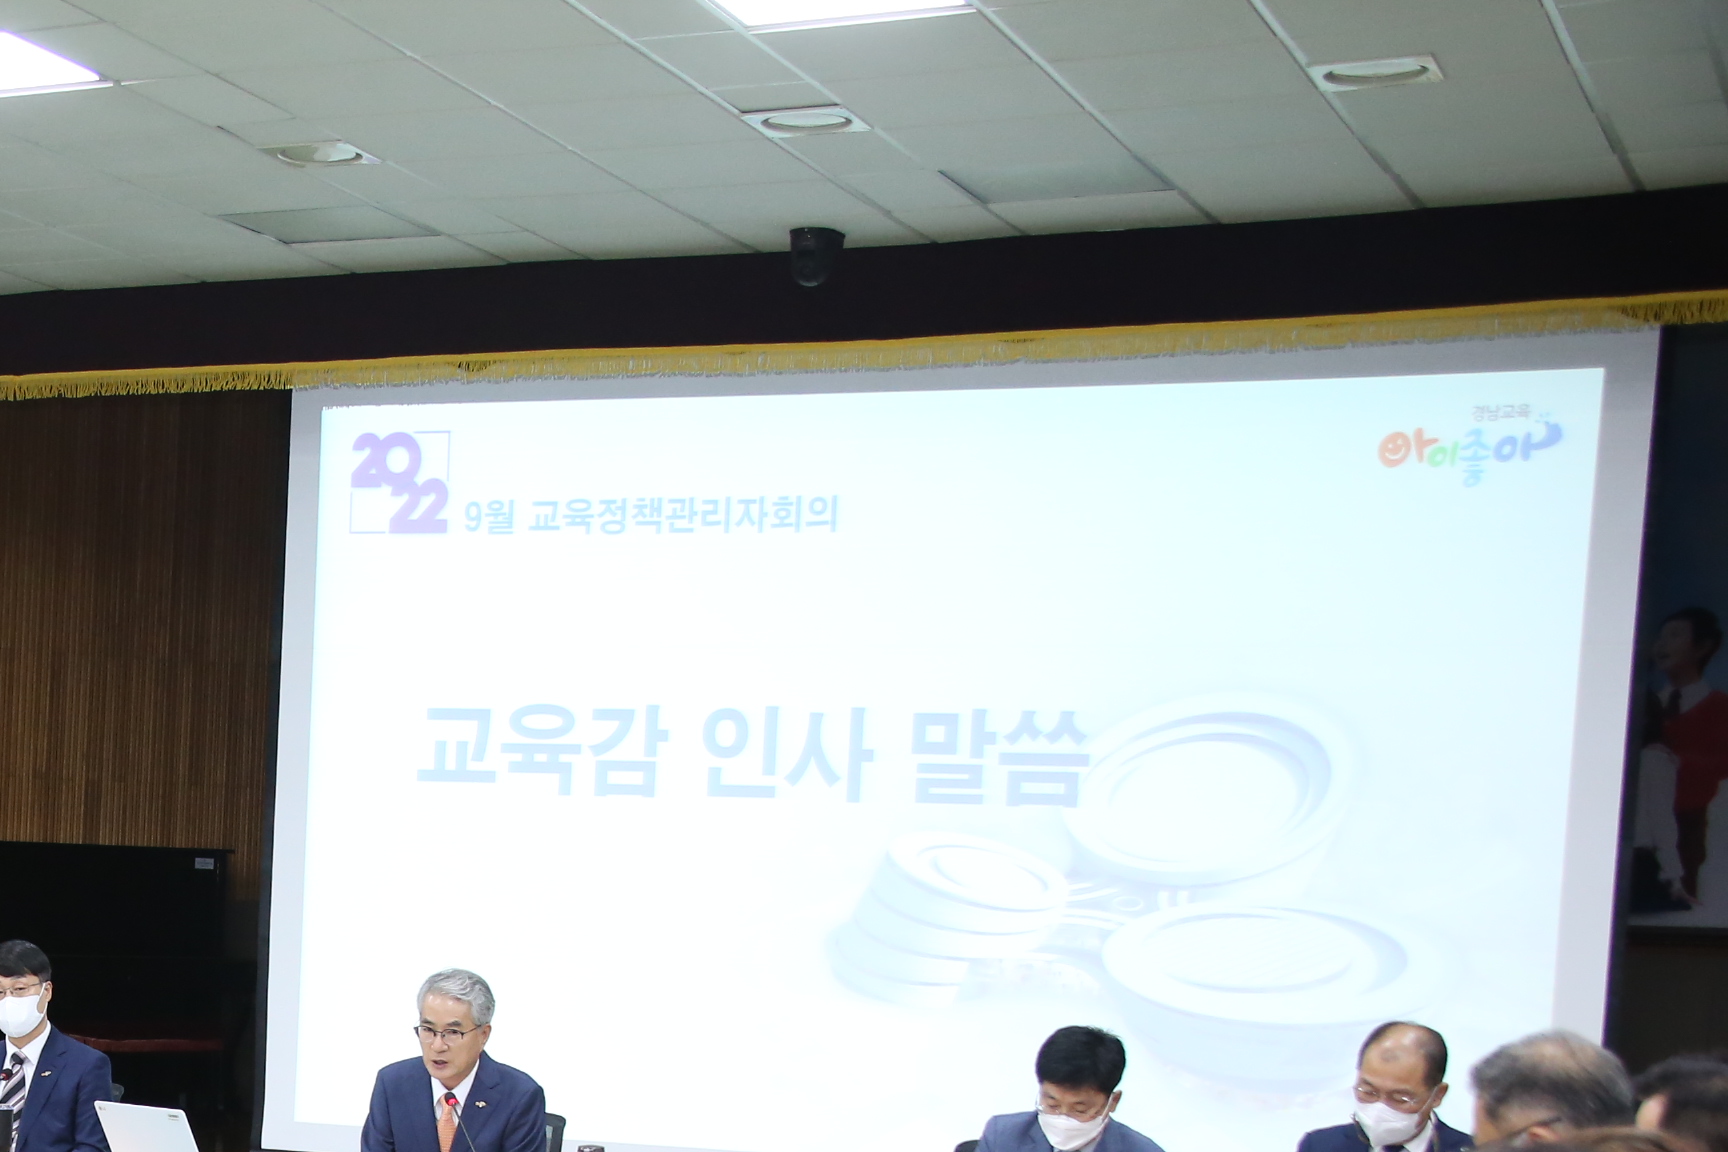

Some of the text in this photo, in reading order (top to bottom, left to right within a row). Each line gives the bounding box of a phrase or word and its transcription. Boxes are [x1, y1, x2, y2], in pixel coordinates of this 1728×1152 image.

[1472, 403, 1532, 422] 경남교육
[1378, 418, 1563, 488] 아이좋아
[463, 493, 839, 535] 9월 교육정책관리자회의
[417, 703, 1090, 808] 교육감 인사 말씀
